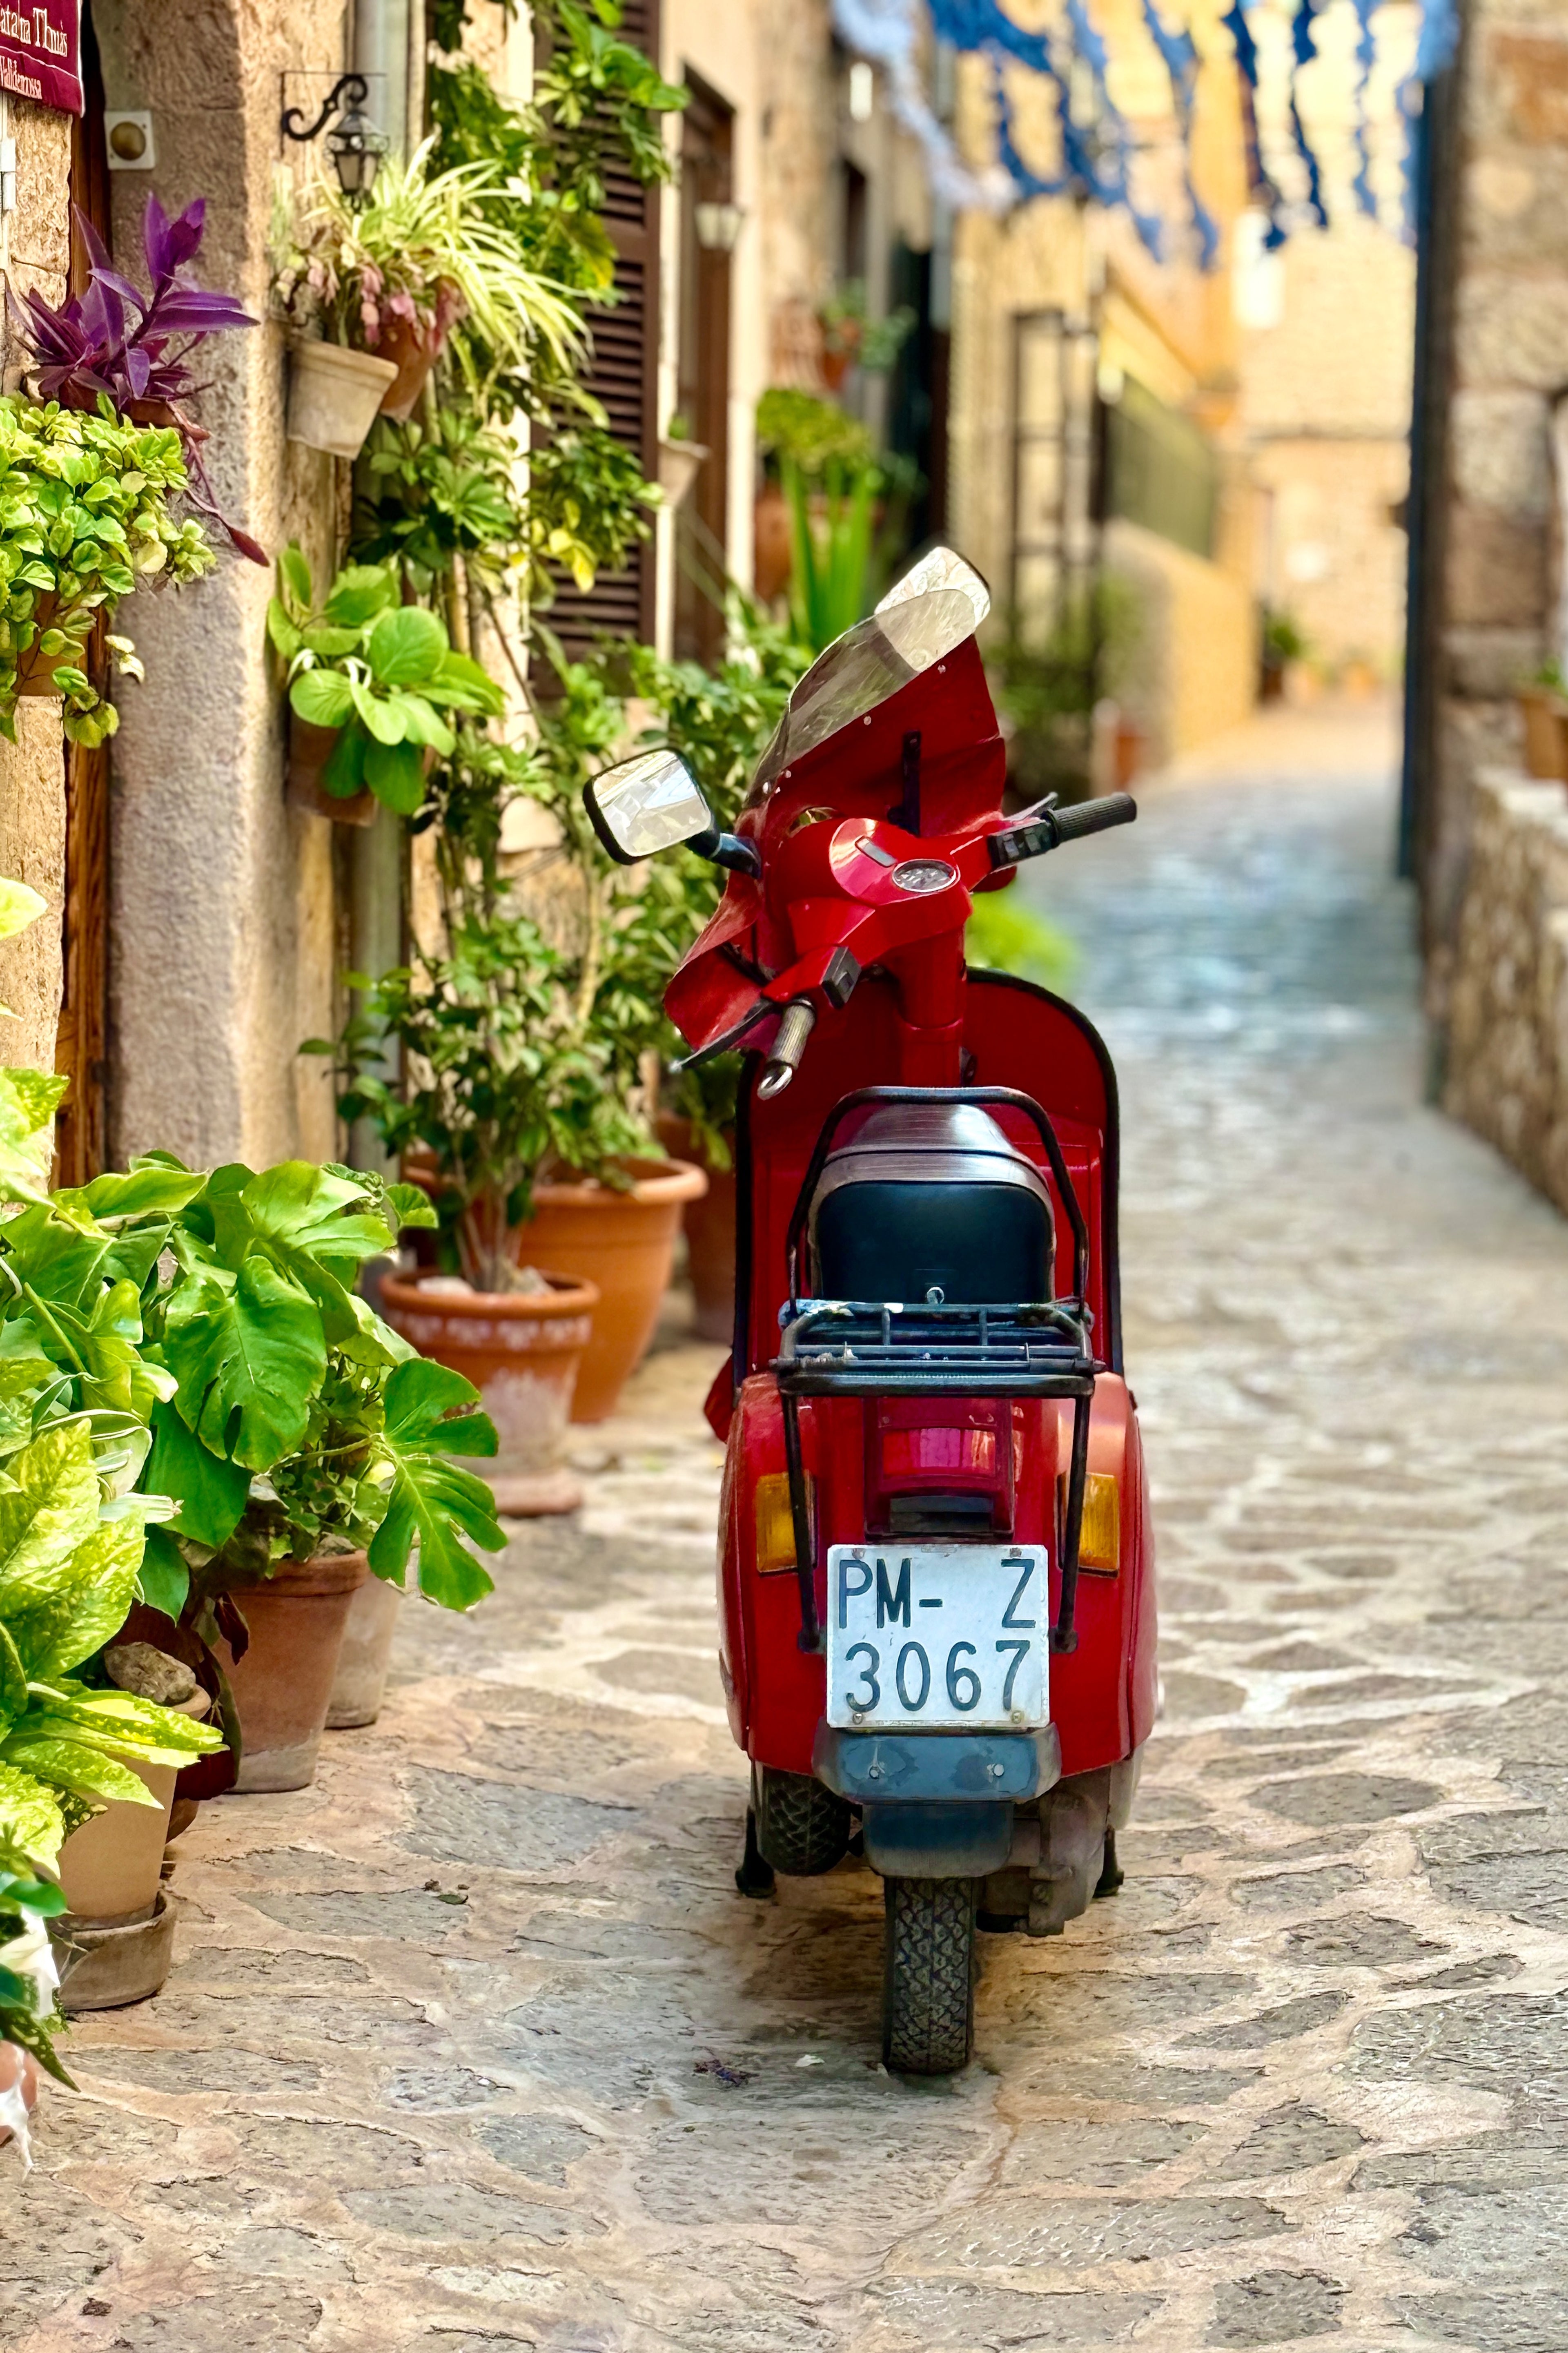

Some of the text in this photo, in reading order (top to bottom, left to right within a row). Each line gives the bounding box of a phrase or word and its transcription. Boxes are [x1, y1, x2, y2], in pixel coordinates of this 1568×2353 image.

[839, 1558, 1036, 1628] PM- Z
[845, 1640, 1030, 1711] 3067
